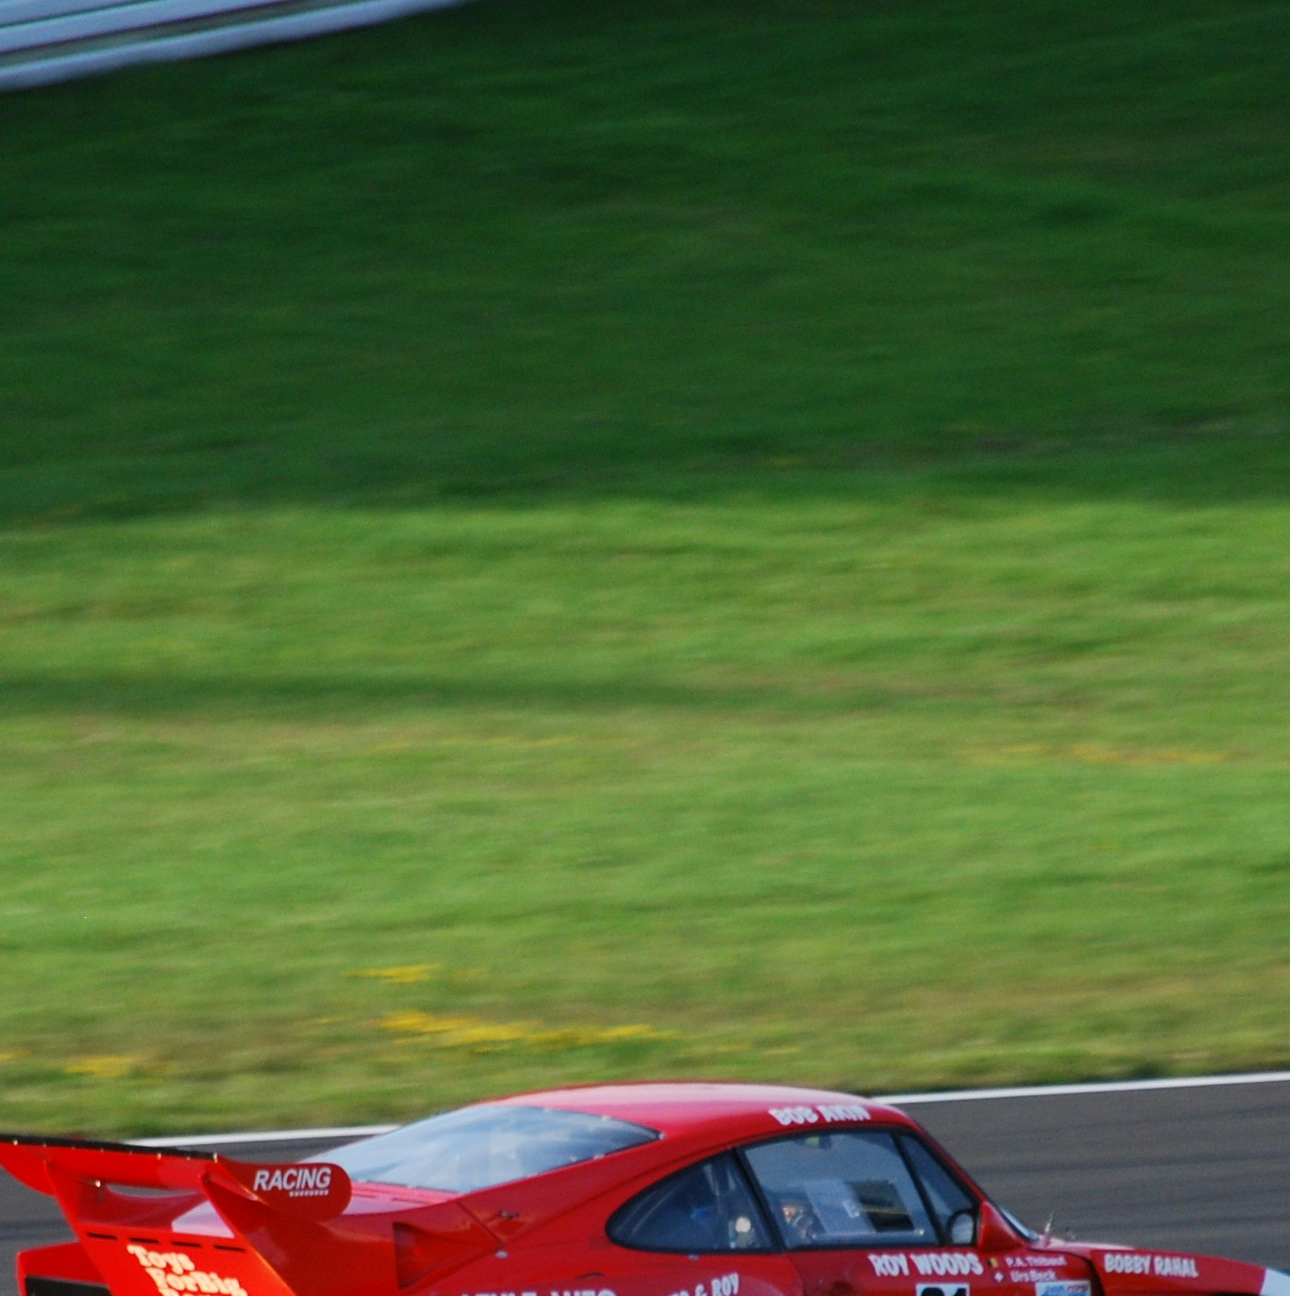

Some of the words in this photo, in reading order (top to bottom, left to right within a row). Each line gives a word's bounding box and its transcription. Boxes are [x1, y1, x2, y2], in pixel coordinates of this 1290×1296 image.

[253, 1167, 332, 1191] RACING
[127, 1244, 195, 1275] Toys
[868, 1252, 909, 1277] ROY
[1104, 1253, 1151, 1275] BOBBY
